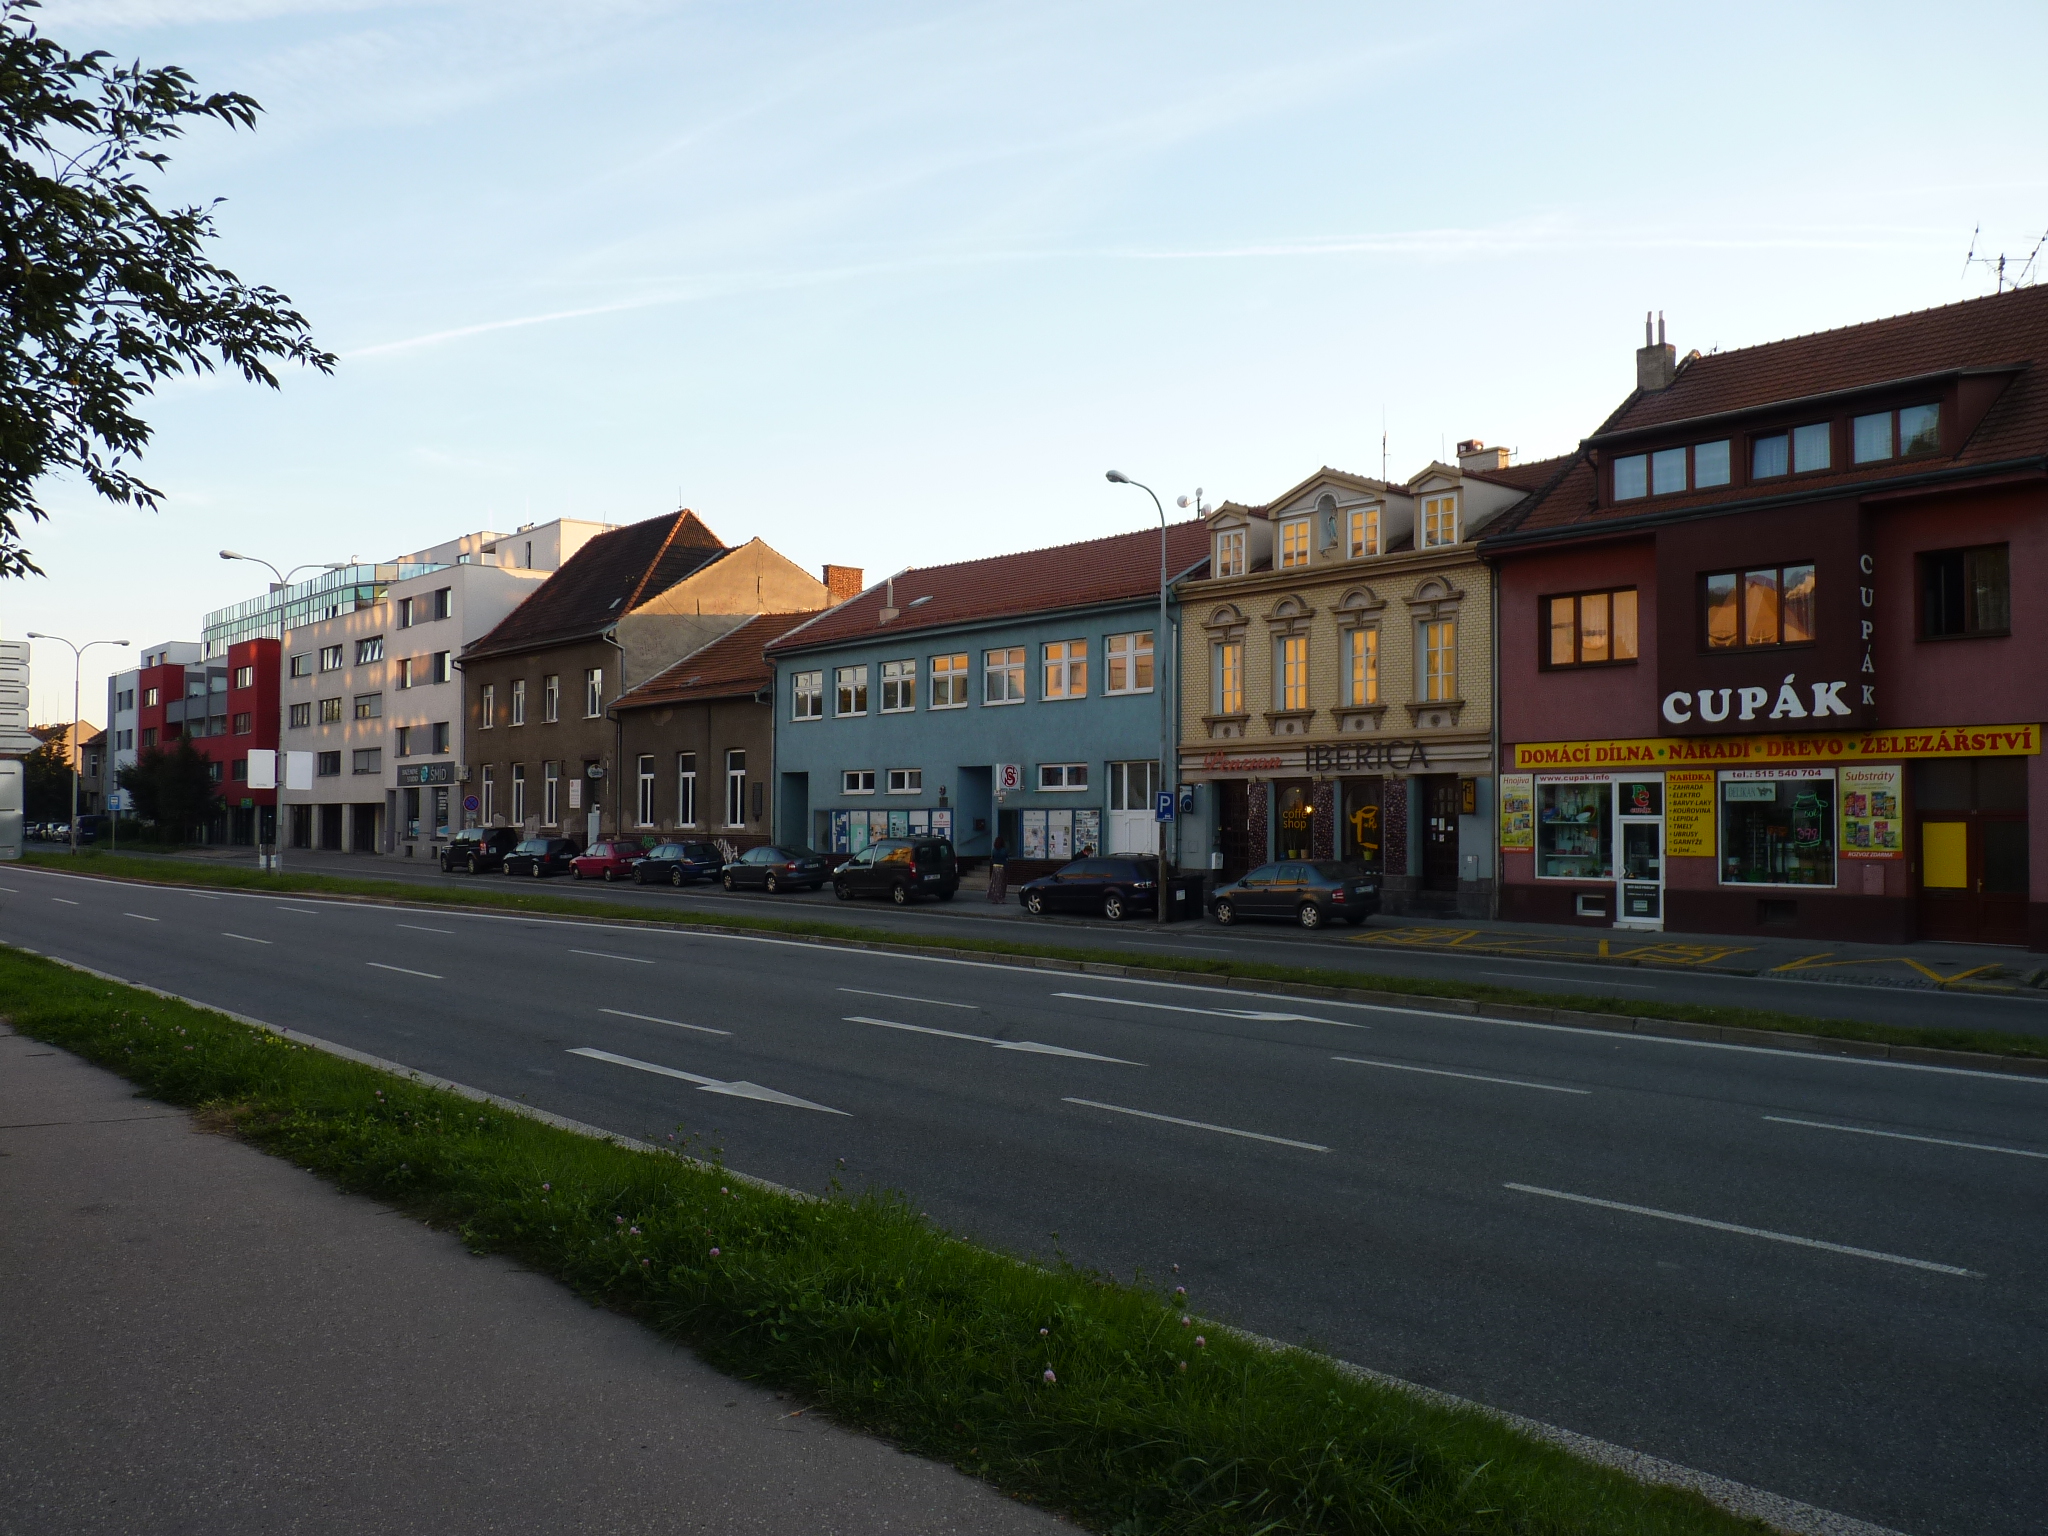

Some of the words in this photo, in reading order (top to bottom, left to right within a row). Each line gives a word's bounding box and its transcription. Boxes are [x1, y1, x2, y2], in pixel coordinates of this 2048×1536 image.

[1859, 554, 1875, 705] CUPÁK
[1662, 673, 1851, 724] CUPÁK
[1520, 744, 1591, 764] DOMÁCÍ
[1595, 742, 1655, 761] DÍLNA
[1668, 736, 1750, 760] NÁŘADÍ
[1766, 735, 1843, 757] DŘEVO
[1860, 727, 2032, 754] ŽELEZÁŘSTVÍ
[1203, 749, 1282, 772] Penzion
[1303, 740, 1429, 771] IBERICA
[1540, 774, 1610, 783] www.cupak.info
[1669, 773, 1711, 782] NABÍDKA
[1755, 770, 1774, 778] 515
[1801, 769, 1821, 777] 704
[1845, 771, 1894, 783] Substráty
[1503, 776, 1530, 786] Hnojiva
[1672, 783, 1704, 791] ZAHRADA
[1672, 791, 1701, 799] ELEKTRO
[1160, 795, 1171, 813] P
[1282, 808, 1308, 819] coffe
[1283, 818, 1307, 832] shop
[1673, 830, 1699, 838] UBRUSY
